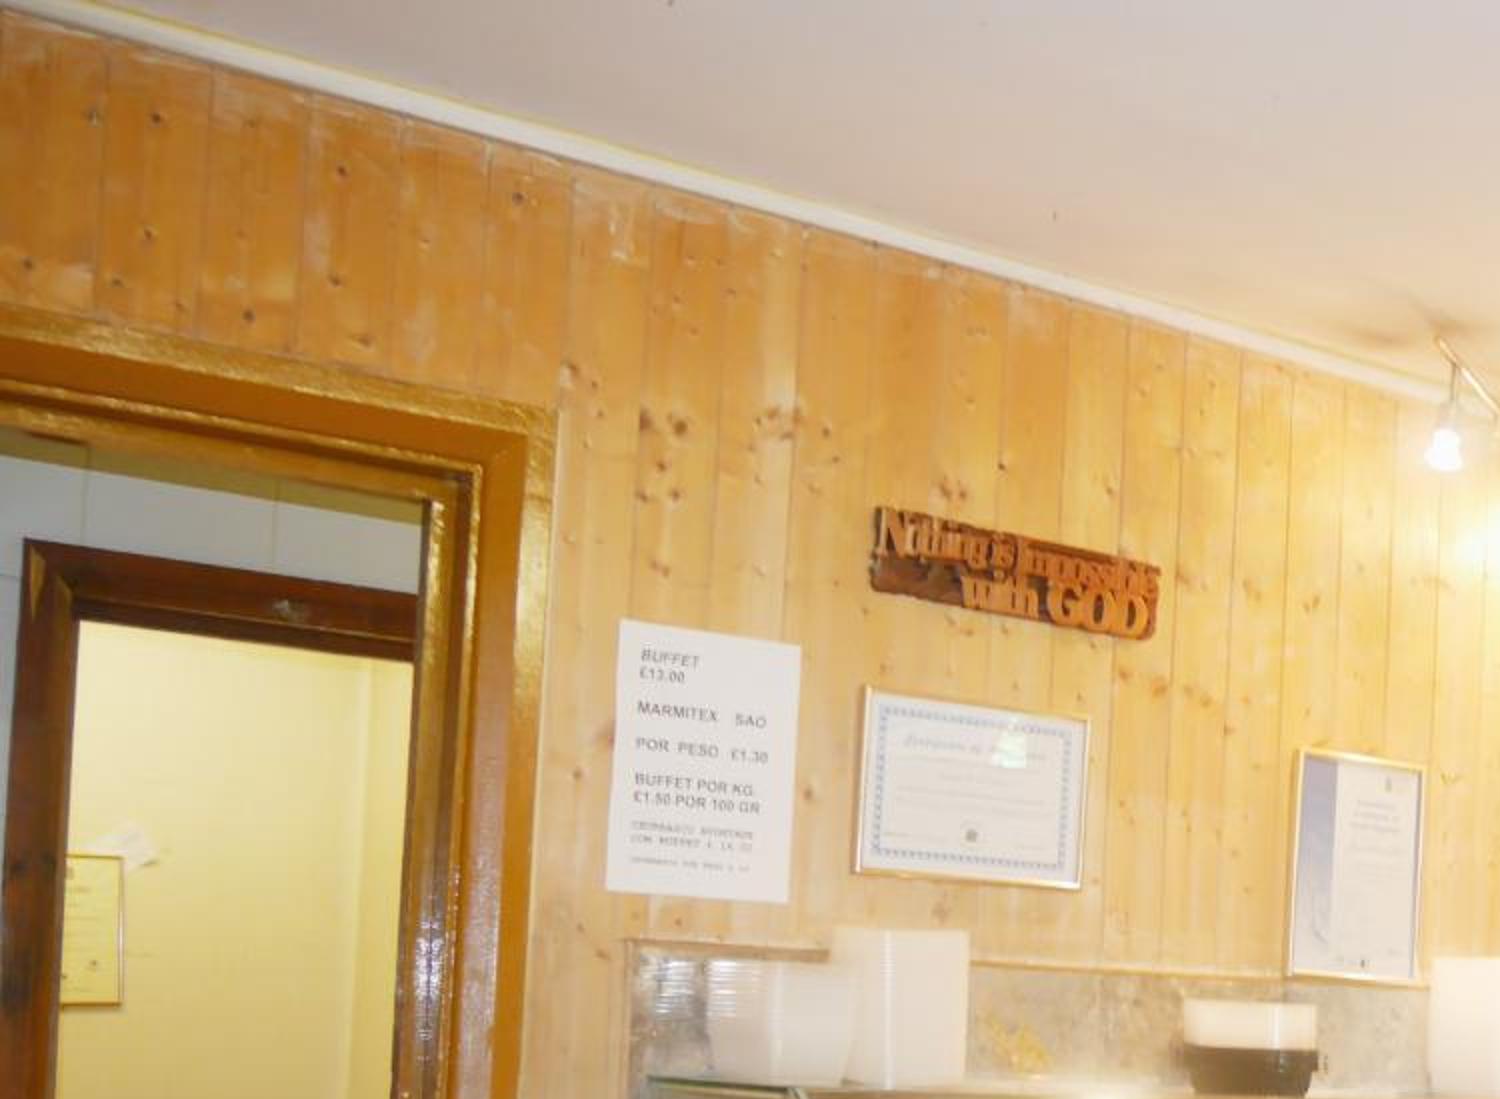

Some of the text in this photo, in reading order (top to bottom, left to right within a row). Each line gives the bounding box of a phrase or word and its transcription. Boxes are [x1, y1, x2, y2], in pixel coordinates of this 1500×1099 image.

[961, 572, 1150, 640] with GOD
[641, 648, 699, 669] BUFFET
[637, 701, 718, 722] MARMITEX
[636, 737, 669, 752] POR
[678, 741, 719, 757] PESO
[634, 772, 692, 789] BUFFET
[697, 778, 727, 794] POR
[675, 793, 706, 810] POR
[712, 799, 734, 812] 100
